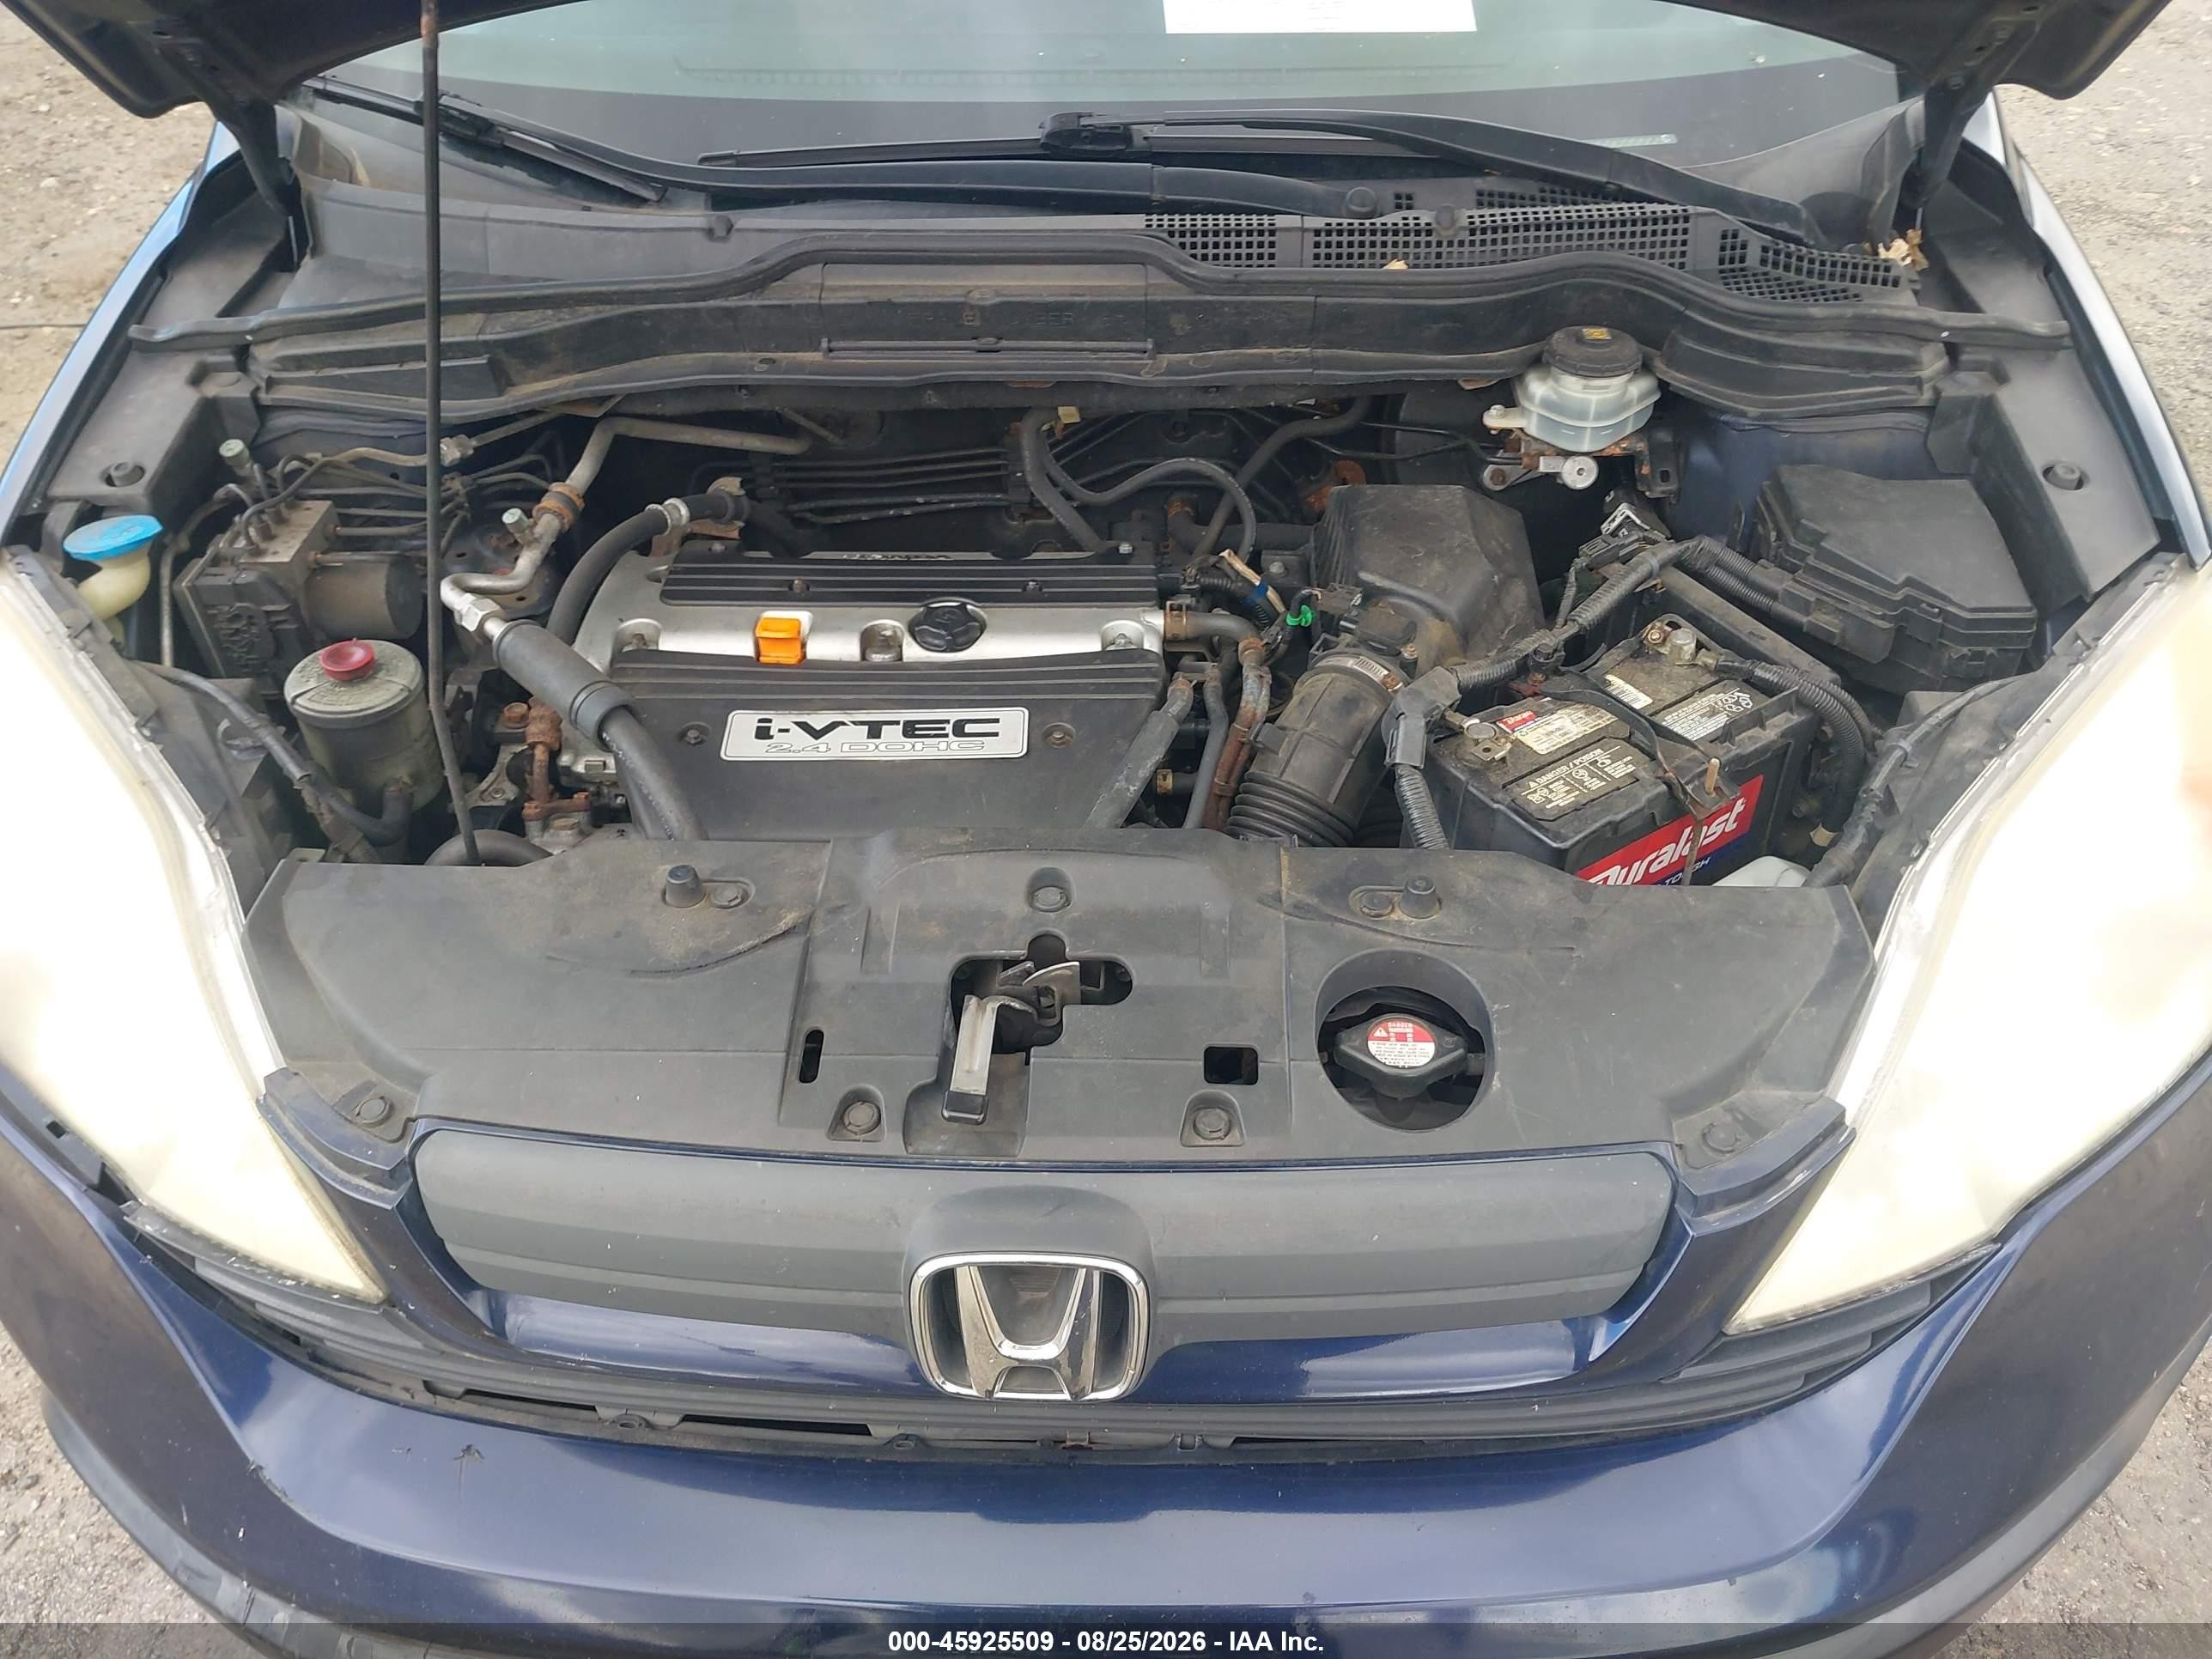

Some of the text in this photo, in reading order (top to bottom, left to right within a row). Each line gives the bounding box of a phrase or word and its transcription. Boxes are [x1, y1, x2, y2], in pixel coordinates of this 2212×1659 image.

[755, 718, 1000, 740] i-VTEC
[766, 740, 984, 754] 2.4 DOHC
[1535, 763, 1571, 785] DANGER
[1572, 748, 1605, 766] POISON
[1664, 857, 1711, 885] TOGH
